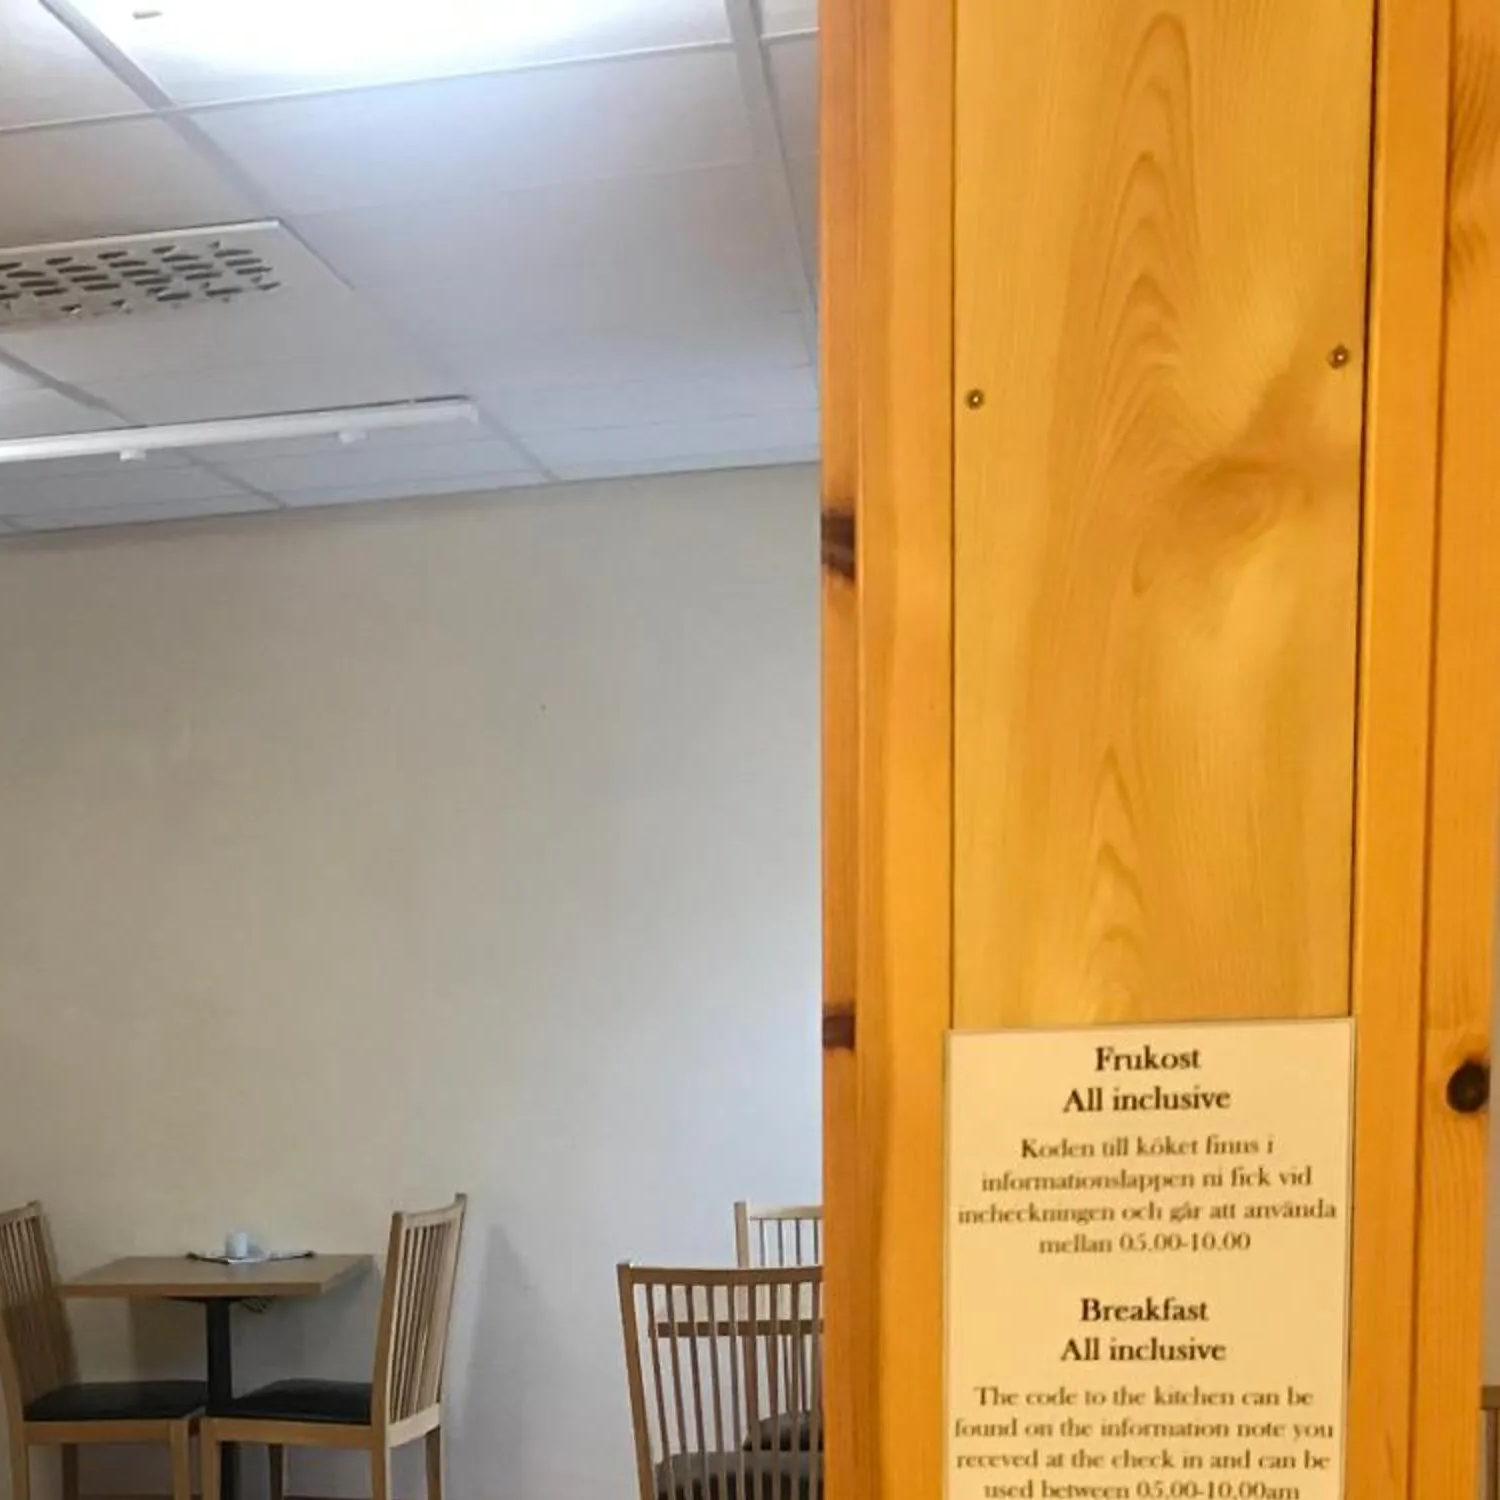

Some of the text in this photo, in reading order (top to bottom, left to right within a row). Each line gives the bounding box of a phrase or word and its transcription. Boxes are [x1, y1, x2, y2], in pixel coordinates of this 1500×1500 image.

[1094, 1045, 1201, 1072] Frukost
[1062, 1085, 1231, 1114] All inclusive
[1021, 1138, 1096, 1159] Koden
[1102, 1136, 1130, 1157] till
[1205, 1134, 1260, 1155] finns
[1267, 1133, 1275, 1154] i
[1202, 1166, 1224, 1188] ni
[1231, 1166, 1272, 1187] fick
[1279, 1164, 1313, 1186] vid
[957, 1197, 1338, 1225] incheckningen och går att använda
[1038, 1230, 1252, 1254] mellan 05.00-10.00
[1080, 1297, 1210, 1323] Breakfast
[1060, 1337, 1227, 1361] All inclusive
[973, 1385, 1315, 1406] The code to the kitchen can be
[954, 1416, 1334, 1443] found on the information note you
[1045, 1453, 1065, 1468] at
[1070, 1448, 1105, 1468] the
[1111, 1448, 1175, 1469] check
[1182, 1449, 1204, 1468] in
[1210, 1448, 1251, 1469] and
[1258, 1452, 1297, 1469] can
[1303, 1448, 1331, 1469] be
[983, 1479, 1034, 1499] used
[1041, 1478, 1131, 1499] between
